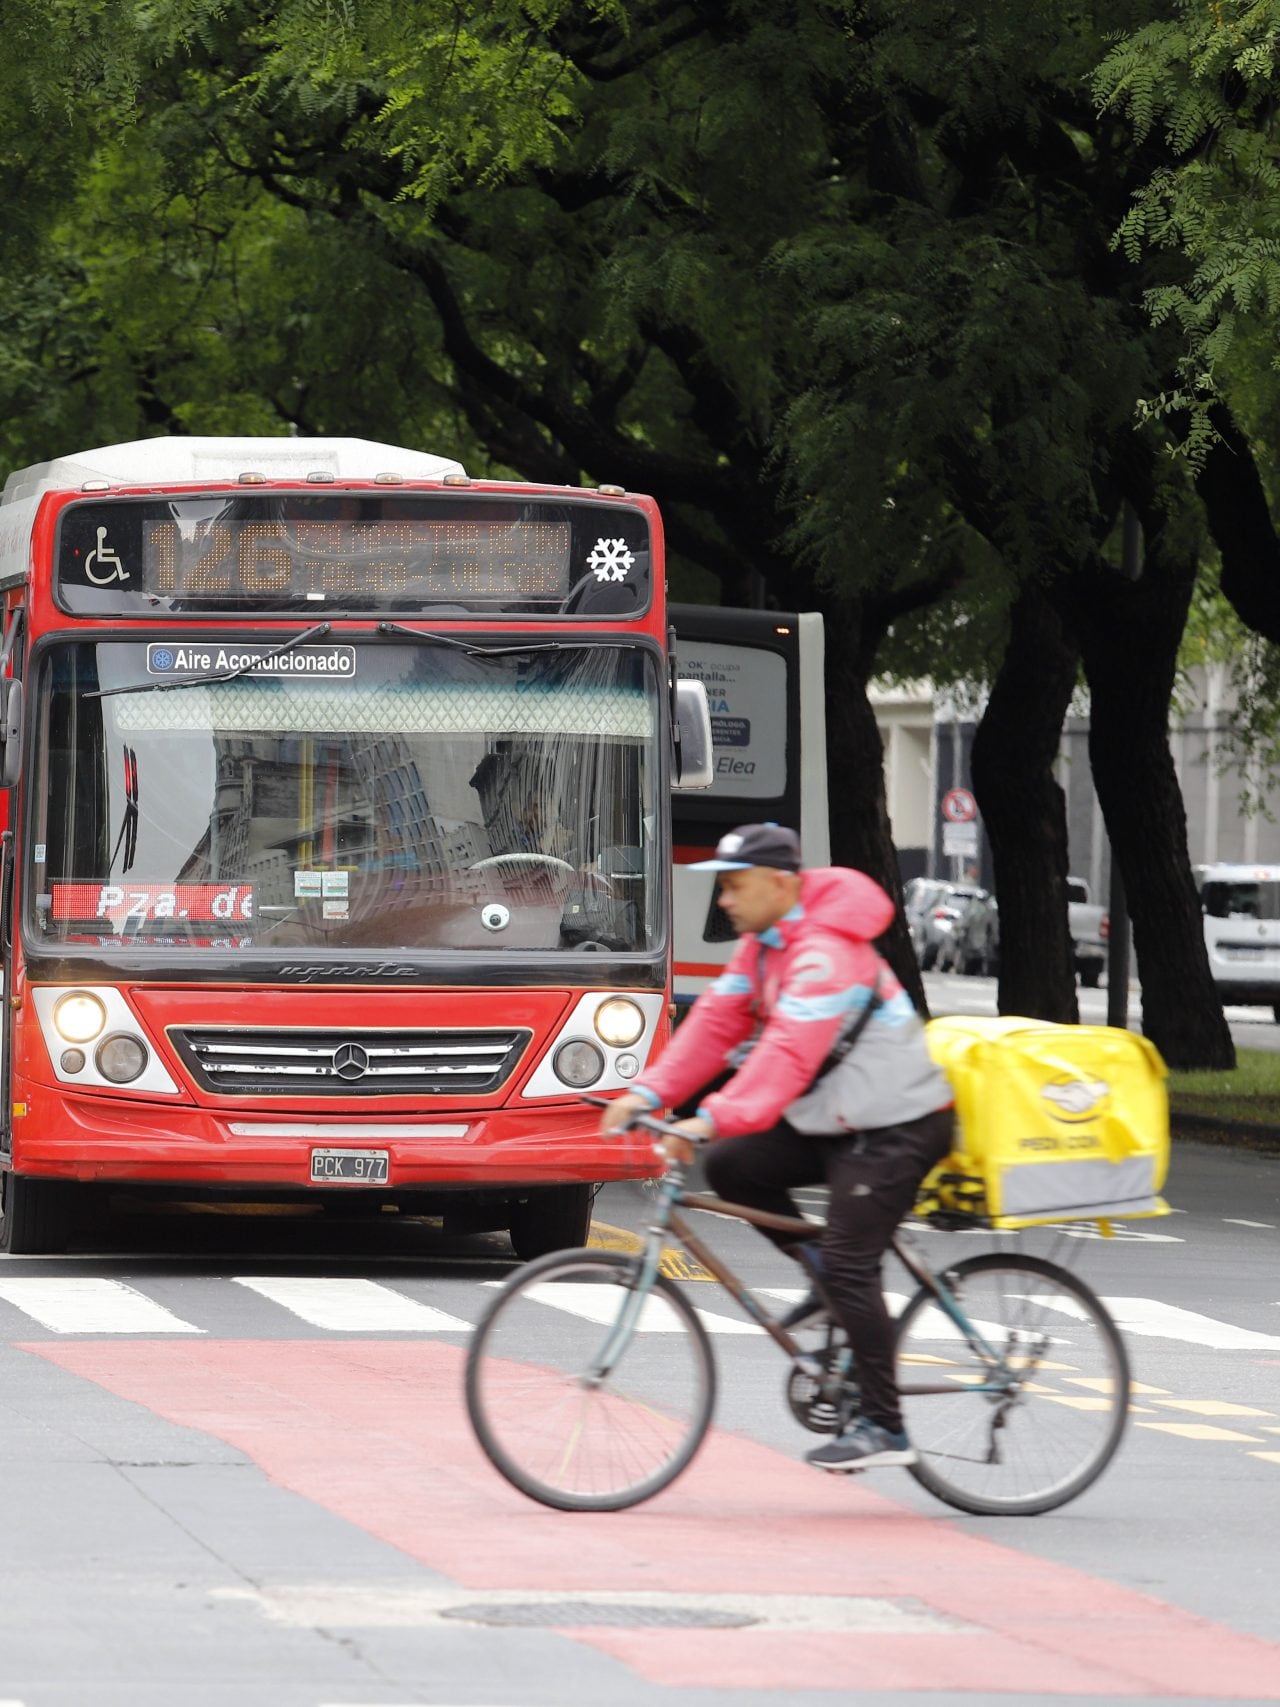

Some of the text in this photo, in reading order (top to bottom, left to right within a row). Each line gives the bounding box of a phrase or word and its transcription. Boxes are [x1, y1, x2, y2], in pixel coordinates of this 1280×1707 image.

[150, 524, 291, 589] 126
[175, 650, 350, 671] Aire Acondicionado
[717, 756, 756, 775] Elea
[96, 886, 188, 917] Pza.
[314, 1157, 385, 1177] PCK 977
